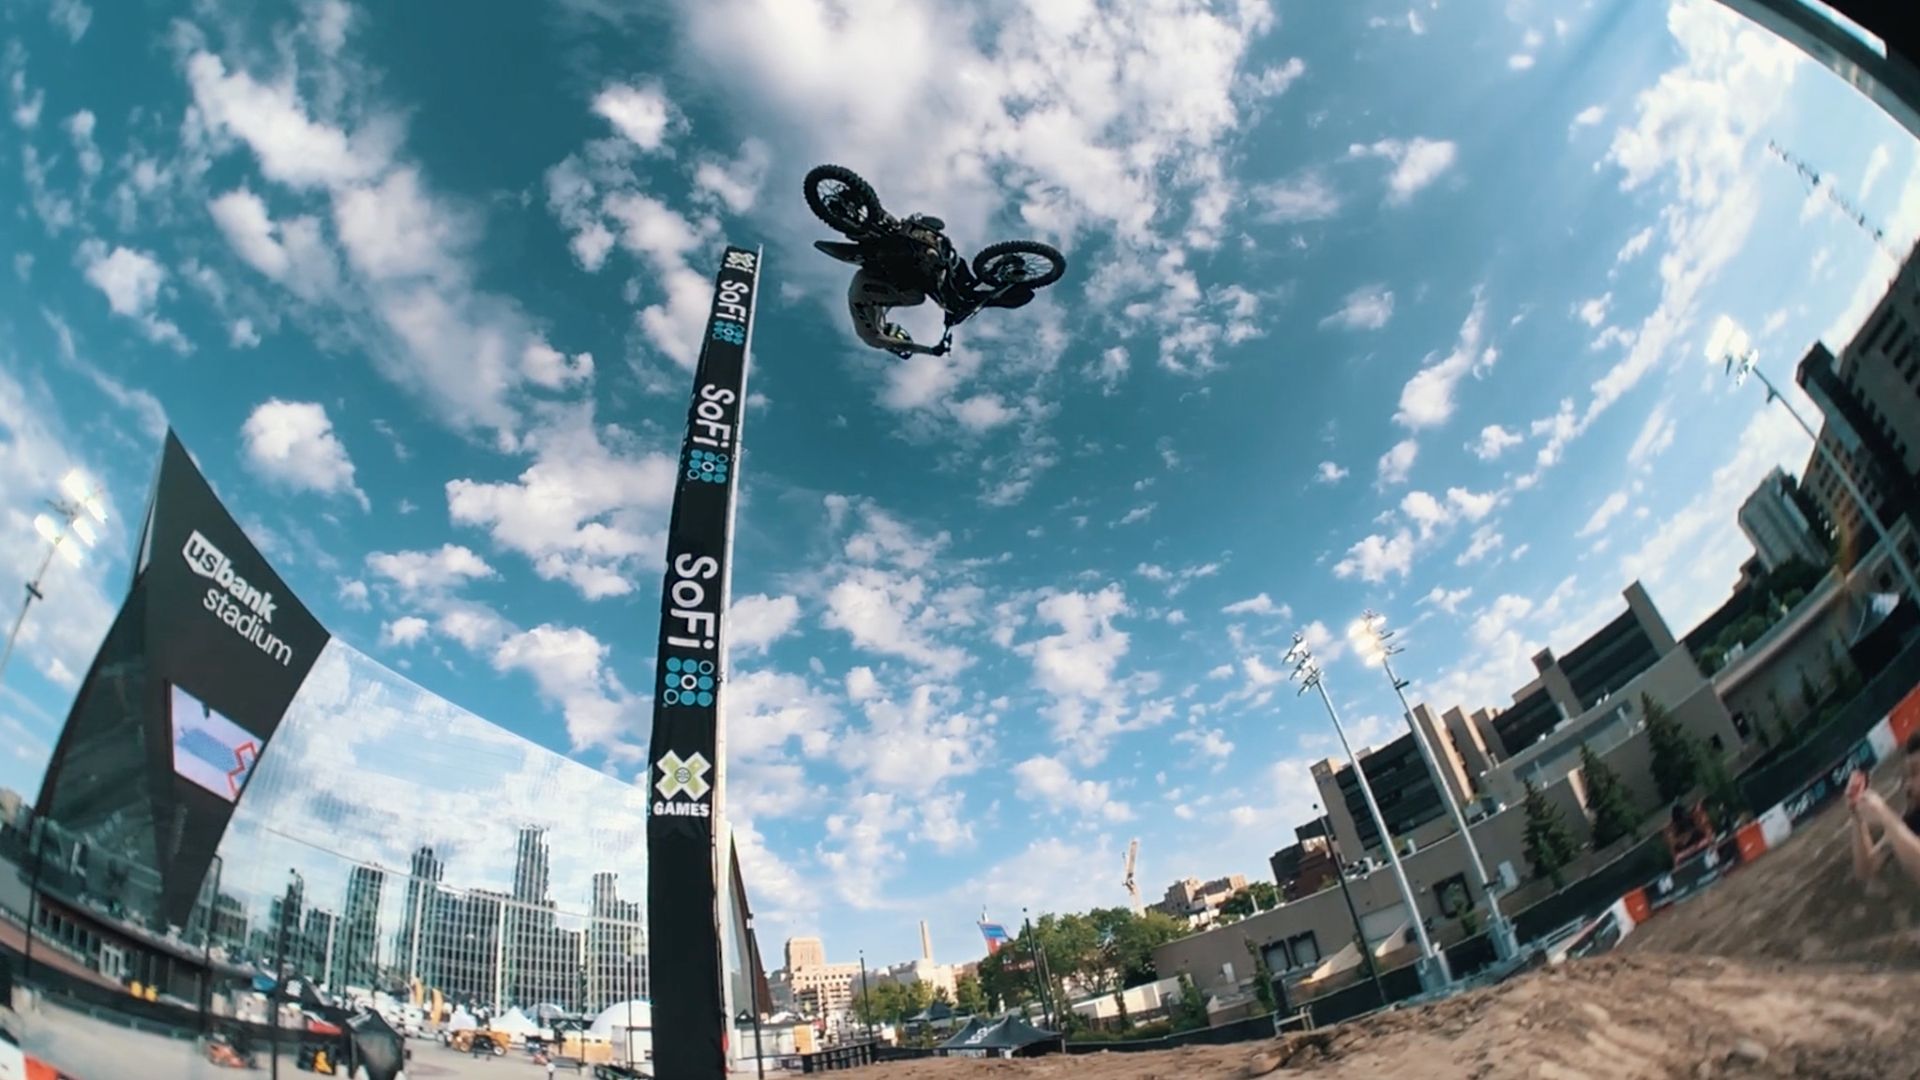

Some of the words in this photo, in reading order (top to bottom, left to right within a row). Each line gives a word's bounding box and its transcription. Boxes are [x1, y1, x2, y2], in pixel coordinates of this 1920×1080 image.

[716, 280, 750, 323] SoFi
[693, 384, 735, 448] SoFi
[203, 588, 292, 666] stadium
[667, 553, 718, 650] SoFi
[653, 801, 710, 817] GAMES
